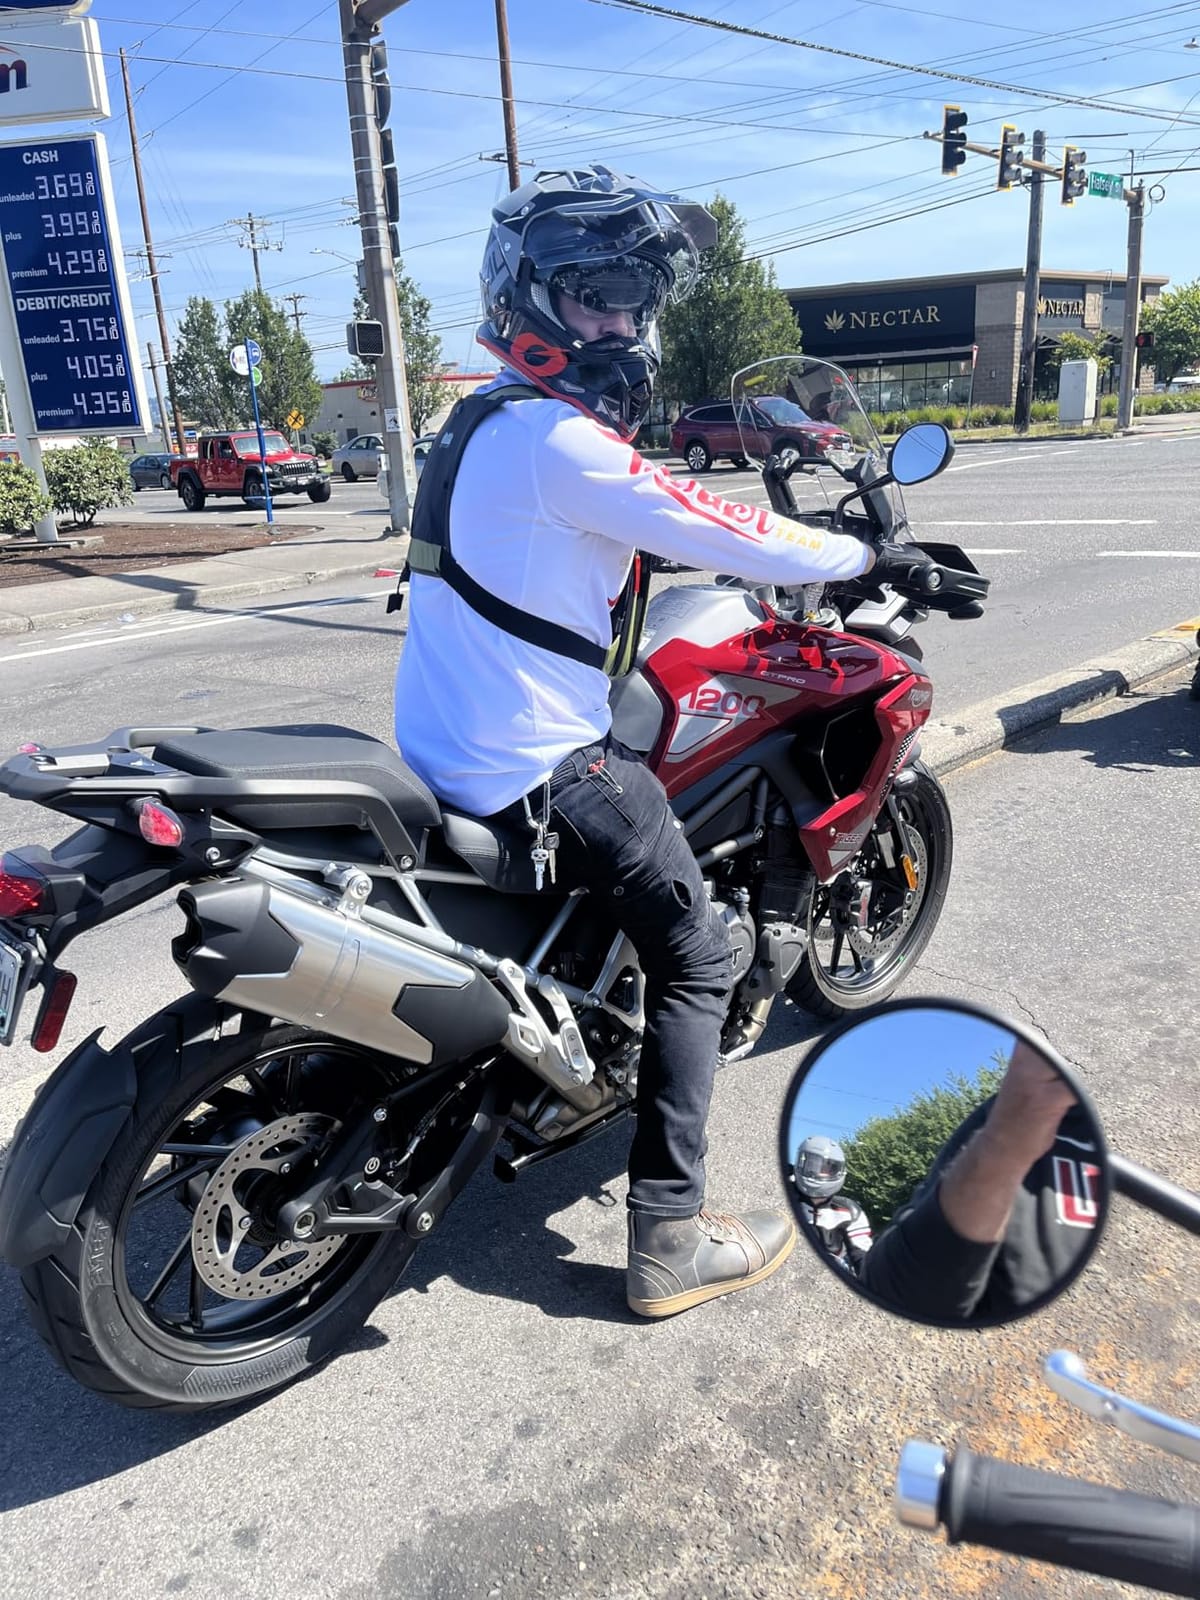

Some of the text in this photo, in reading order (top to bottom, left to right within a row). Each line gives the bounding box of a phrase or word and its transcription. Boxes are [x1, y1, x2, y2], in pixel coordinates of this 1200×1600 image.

[22, 150, 59, 165] CASH
[0, 192, 35, 203] unleaded
[35, 172, 84, 200] 3.69
[5, 232, 22, 242] plus
[41, 211, 90, 238] 3.99
[11, 268, 48, 280] premium
[47, 249, 96, 275] 4.29
[16, 293, 111, 312] DEBIT/CREDIT
[1047, 299, 1085, 315] NECTAR
[849, 305, 941, 329] NECTAR
[24, 334, 60, 345] unleaded
[59, 318, 108, 343] 3.75
[30, 372, 48, 383] plus
[66, 355, 114, 379] 4.05
[37, 407, 74, 419] premium
[73, 391, 121, 415] 4.35
[687, 688, 767, 717] 1200
